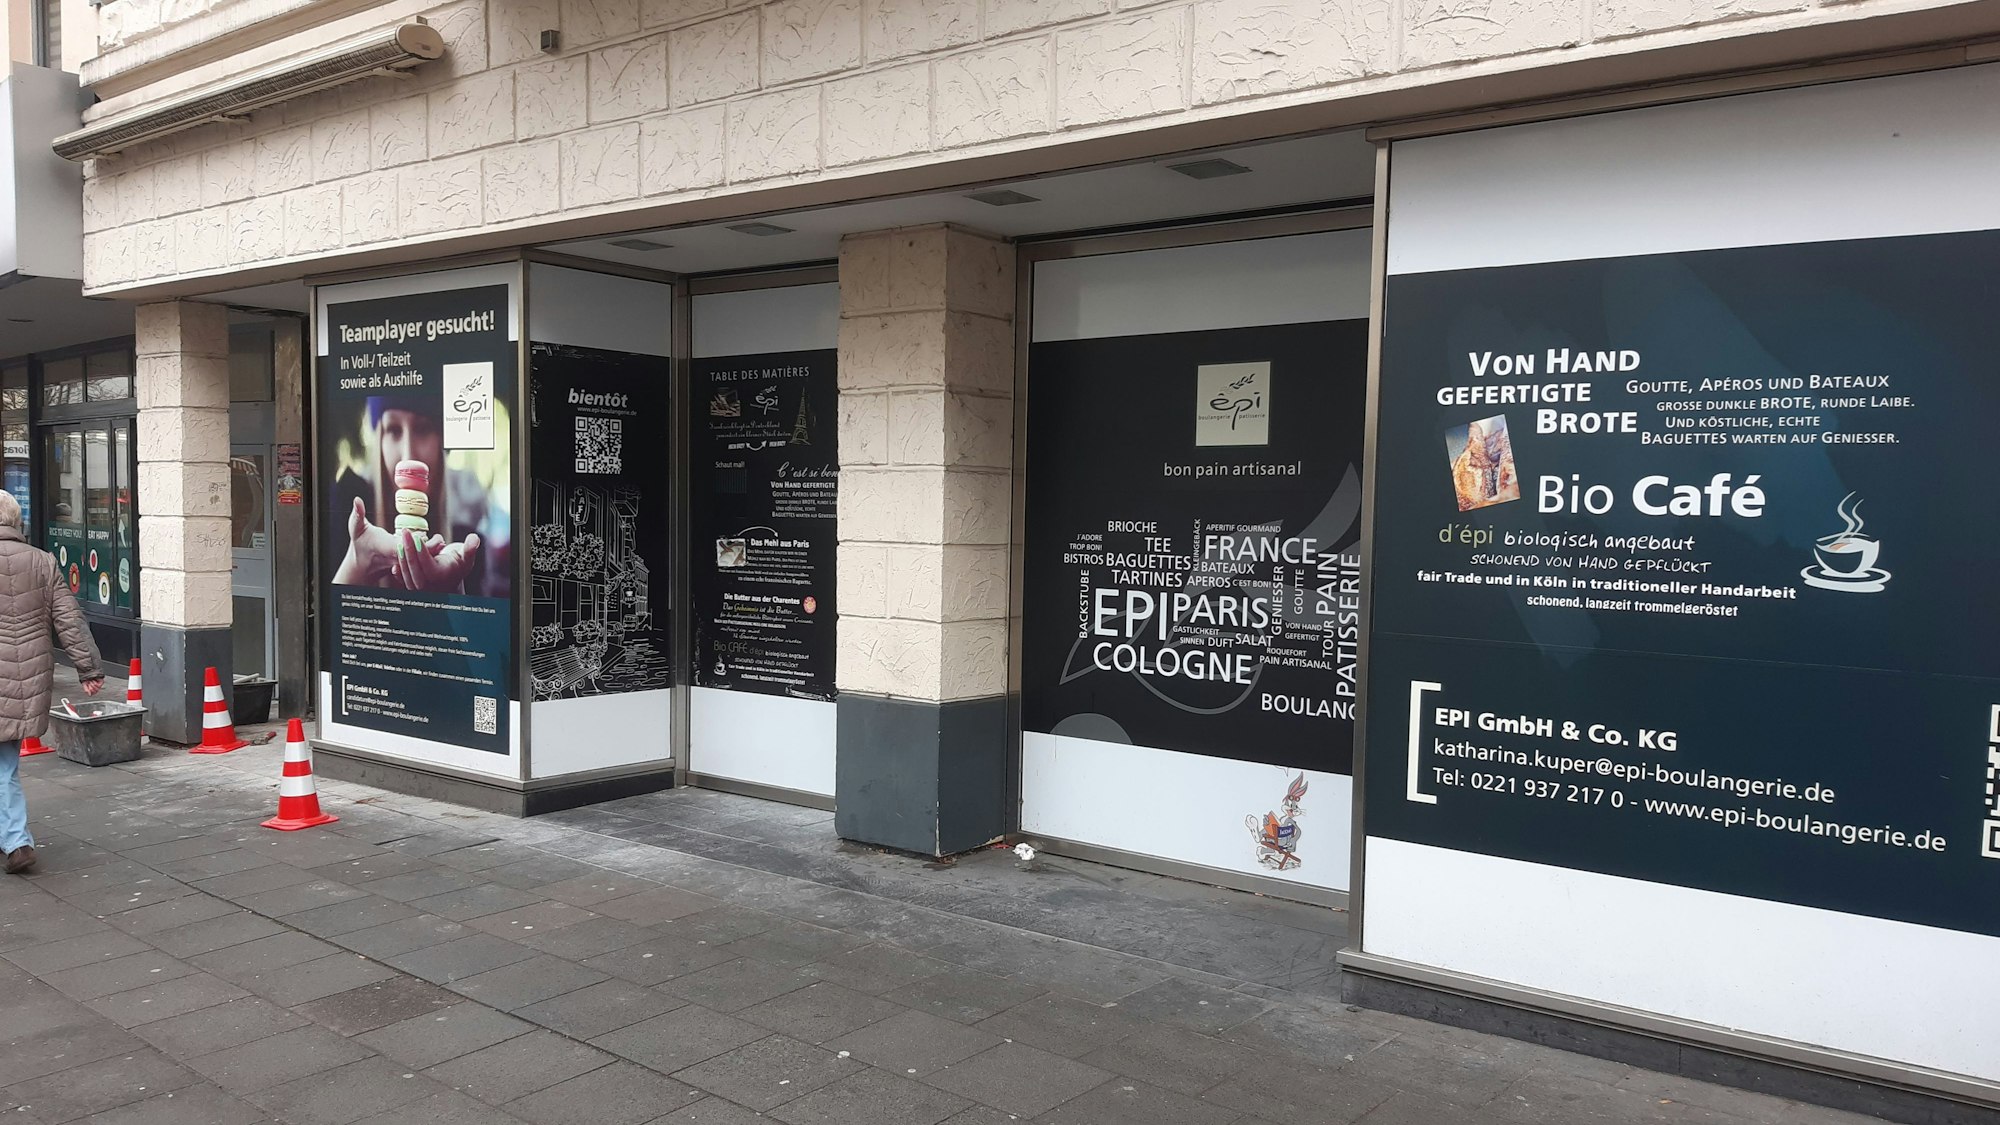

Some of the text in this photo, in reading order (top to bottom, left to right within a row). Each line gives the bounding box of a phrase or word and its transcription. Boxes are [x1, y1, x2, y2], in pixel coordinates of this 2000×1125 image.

[340, 310, 495, 345] Teamplayer gesucht!
[341, 352, 411, 369] In Voll-/ Teilzeit
[1469, 348, 1641, 377] VON HAND
[341, 371, 423, 390] sowie als Aushilfe
[710, 371, 738, 381] TABLE
[742, 370, 759, 380] DES
[1626, 380, 1693, 394] GOUTTE,
[1768, 378, 1803, 390] UND
[1809, 374, 1890, 389] BATEAUX
[568, 388, 628, 408] bientôt
[1437, 383, 1592, 405] GEFERTIGTE
[1657, 396, 1915, 411] GROSSE DUNKLE BROTE, RUNDE LAIBE.
[1536, 409, 1638, 434] BROTE
[1666, 416, 1820, 428] UND KÖSTLICHE, ECHTE
[1641, 432, 1900, 445] BAGUETTES WARTEN AUF GENIESSER.
[809, 467, 819, 477] si
[1164, 461, 1301, 479] bon pain artisanal
[1538, 472, 1766, 518] Bio Café
[88, 530, 109, 540] EAT HAPPY
[1108, 521, 1157, 533] BRIOCHE
[1206, 524, 1281, 533] APERITIF GOURMAND
[764, 539, 779, 547] Mehl
[793, 540, 810, 548] Paris
[1145, 537, 1171, 552] TEE
[1193, 519, 1201, 572] KLEINGEBÄCK
[1205, 535, 1317, 564] FRANCE
[1504, 530, 1598, 551] biologisch
[1604, 534, 1696, 554] angebaut
[1064, 553, 1104, 565] BISTROS
[1106, 553, 1191, 571] BAGUETTES
[1470, 553, 1712, 574] SCHONEND VON HAND GEPFLÜCKT
[1201, 562, 1254, 575] BATEAUX
[1112, 569, 1182, 587] TARTINES
[1187, 575, 1230, 588] APEROS
[1253, 580, 1271, 588] BON!
[1316, 553, 1338, 615] PAIN
[1417, 570, 1796, 599] fair Trade und in Köln in traditioneller Handarbeit
[1272, 566, 1284, 636] GENIESSER
[1294, 569, 1305, 615] GOUTTE
[1079, 570, 1090, 639] BACKSTUBE
[1173, 593, 1269, 629] PARIS
[1586, 598, 1632, 612] langzeit
[1635, 600, 1738, 617] trommelgeröstet
[1095, 588, 1168, 641] EPI
[1173, 625, 1219, 636] GASTLICHKEIT
[1285, 622, 1322, 631] VON HAND
[1336, 554, 1360, 697] PATISSERIE
[1180, 637, 1204, 646] SINNEN
[1208, 637, 1234, 648] DUFT
[1235, 633, 1274, 647] SALAT
[1285, 633, 1319, 641] GEFERTIGT
[1322, 620, 1334, 658] TOUR
[1267, 647, 1307, 657] ROQUEFORT
[1093, 642, 1253, 685] COLOGNE
[1259, 656, 1332, 670] PAIN ARTISANAL
[354, 685, 368, 693] GmbH
[1435, 707, 1677, 752] EPI GmbH & Co. KG
[1434, 738, 1835, 804] katharina.kuper@epi-boulangerie.de
[1433, 767, 1464, 787] Tel:
[1471, 773, 1516, 794] 0221
[1524, 779, 1560, 799] 937
[1567, 785, 1604, 805] 217
[1611, 791, 1623, 808] 0
[1645, 799, 1947, 852] www.epi-boulangerie.de
